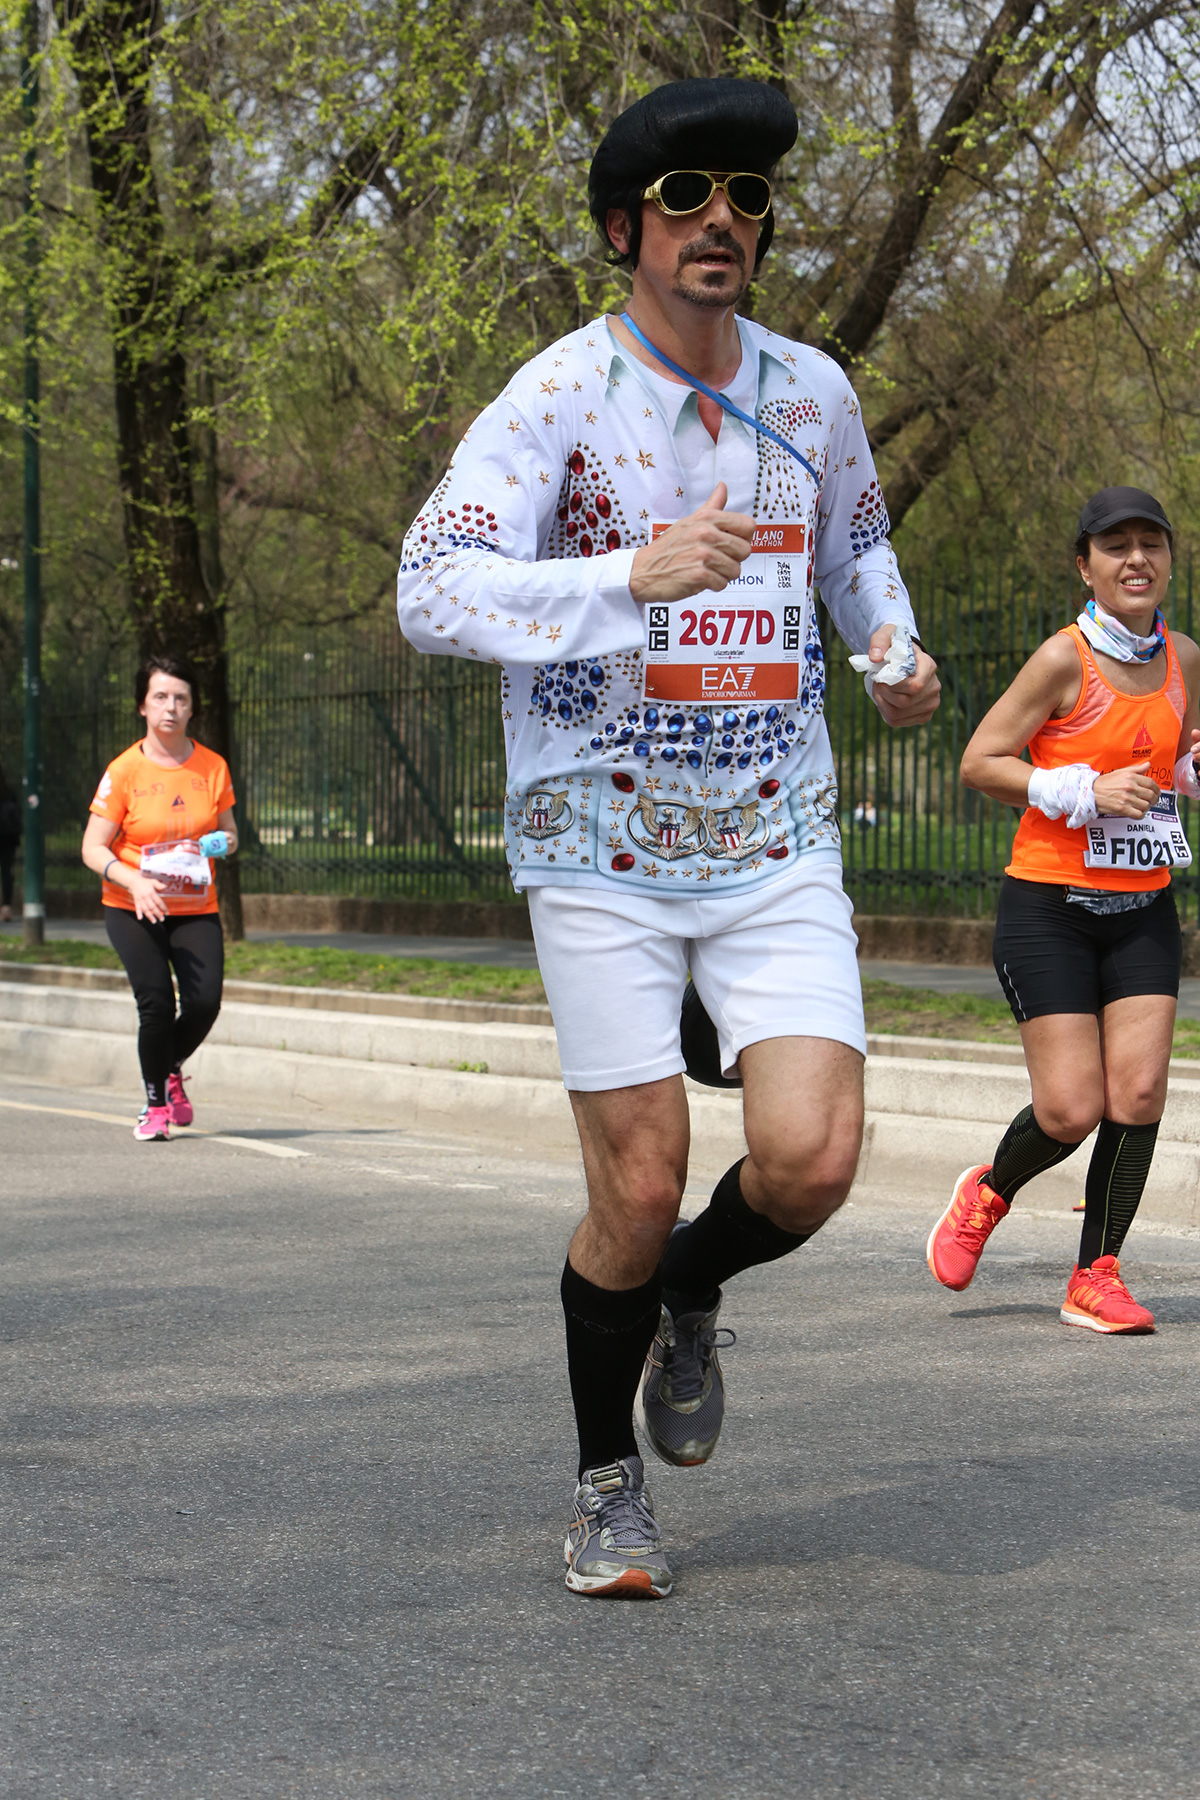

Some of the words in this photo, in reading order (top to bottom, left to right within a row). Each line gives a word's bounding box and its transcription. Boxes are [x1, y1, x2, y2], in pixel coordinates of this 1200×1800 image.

[752, 530, 784, 541] ILANO
[679, 609, 775, 646] 2677D
[702, 667, 756, 690] EA7
[1127, 824, 1155, 833] DANIELA
[1110, 837, 1175, 866] F1021
